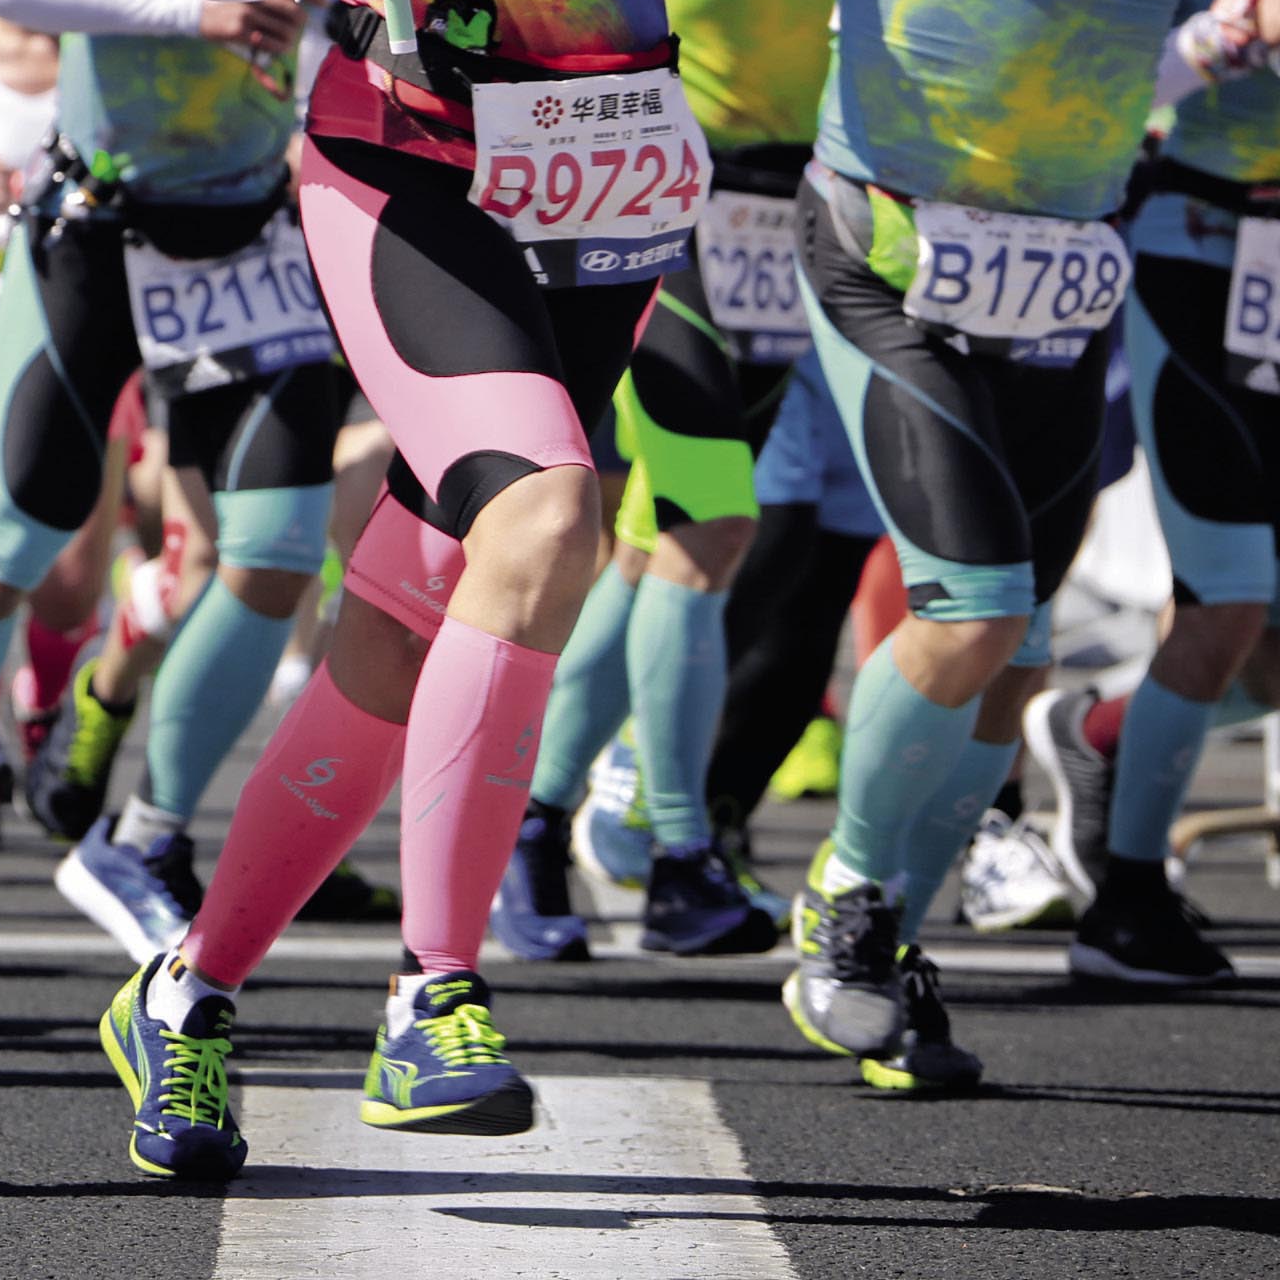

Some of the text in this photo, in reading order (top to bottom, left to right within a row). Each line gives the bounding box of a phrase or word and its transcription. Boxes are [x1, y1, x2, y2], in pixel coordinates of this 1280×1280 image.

[571, 88, 664, 122] 华夏幸福
[479, 139, 701, 226] B9724
[143, 261, 322, 343] B2110
[923, 242, 1121, 320] B1788
